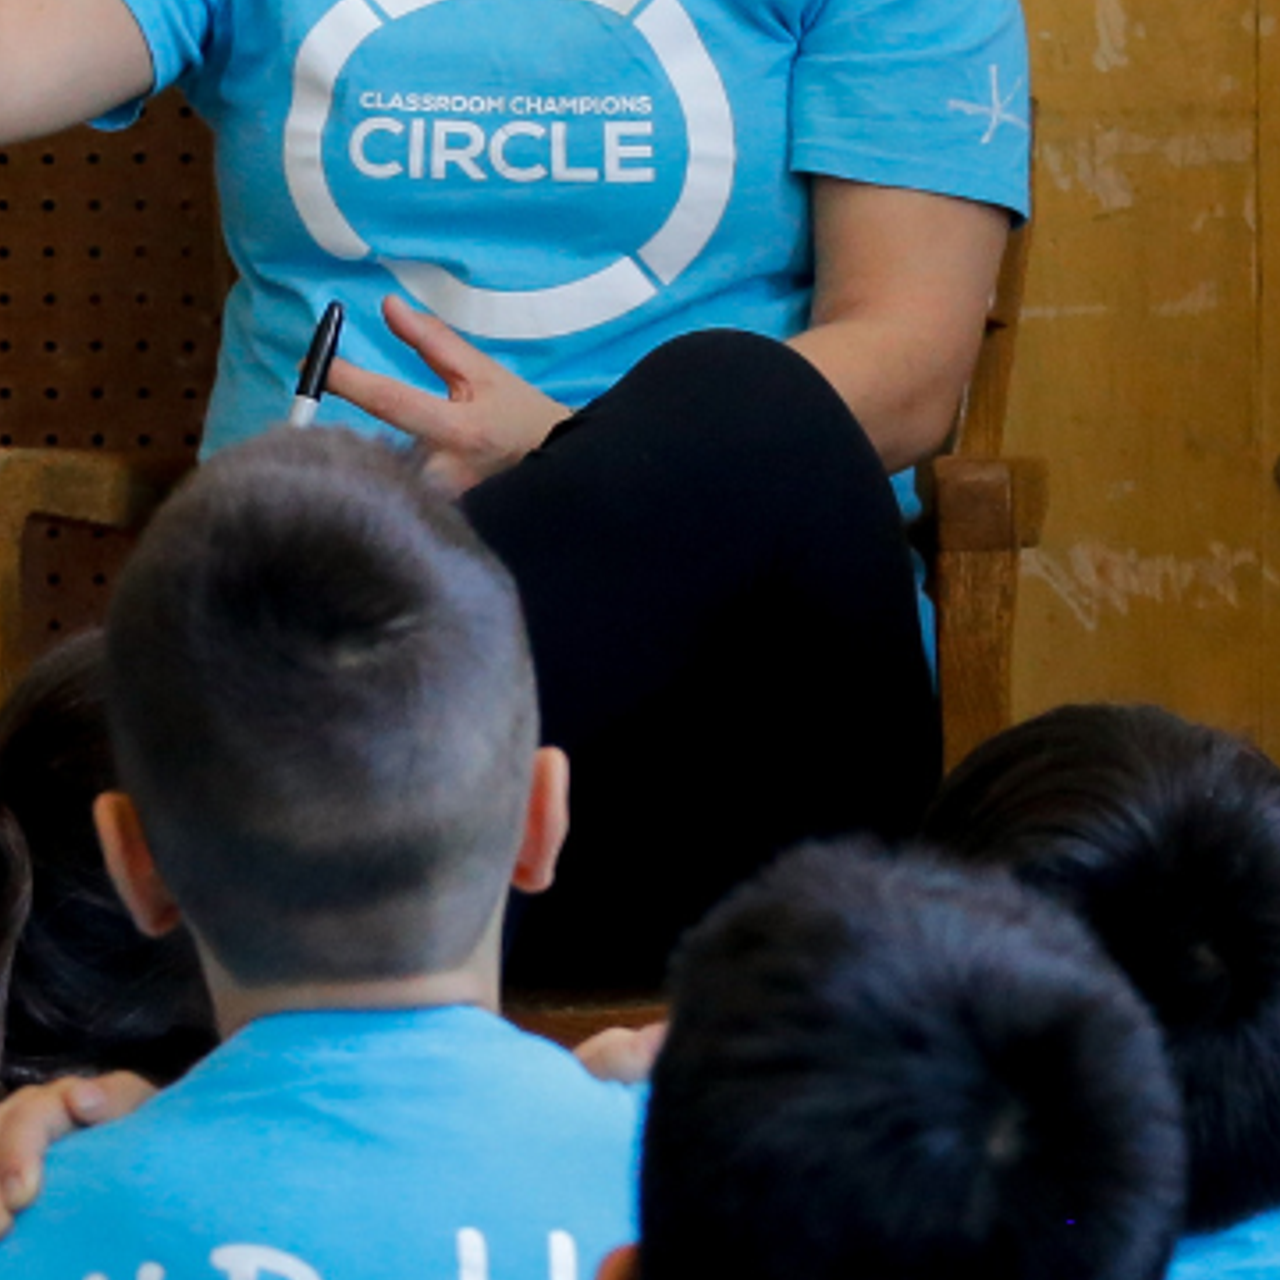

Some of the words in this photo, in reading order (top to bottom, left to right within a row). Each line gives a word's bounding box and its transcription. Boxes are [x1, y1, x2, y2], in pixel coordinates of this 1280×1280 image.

[359, 91, 503, 114] CLASSROOM
[508, 94, 653, 116] CHAMPIONS
[348, 115, 657, 184] CIRCLE
